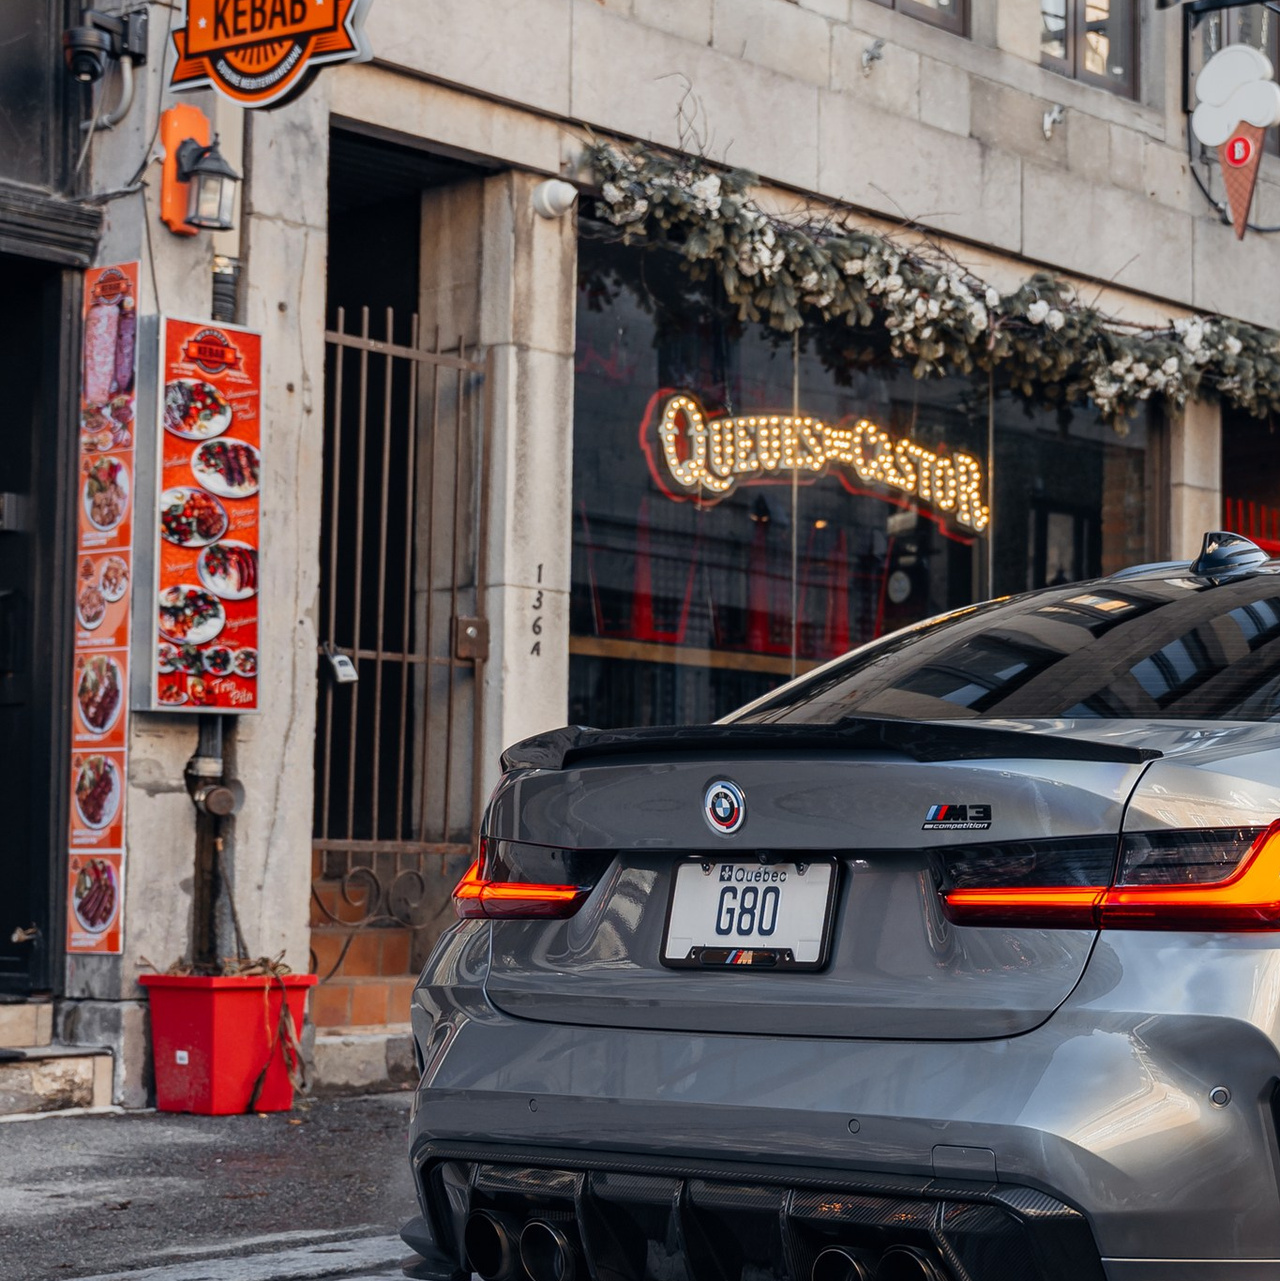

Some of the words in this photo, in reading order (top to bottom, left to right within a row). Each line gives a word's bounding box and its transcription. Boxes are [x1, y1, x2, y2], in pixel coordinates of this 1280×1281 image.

[1233, 141, 1245, 160] B
[659, 395, 825, 493] QUEUES
[851, 419, 989, 532] CASTOR
[942, 804, 992, 821] M3
[933, 822, 988, 830] competition
[735, 867, 788, 883] Québec
[715, 886, 780, 936] G80
